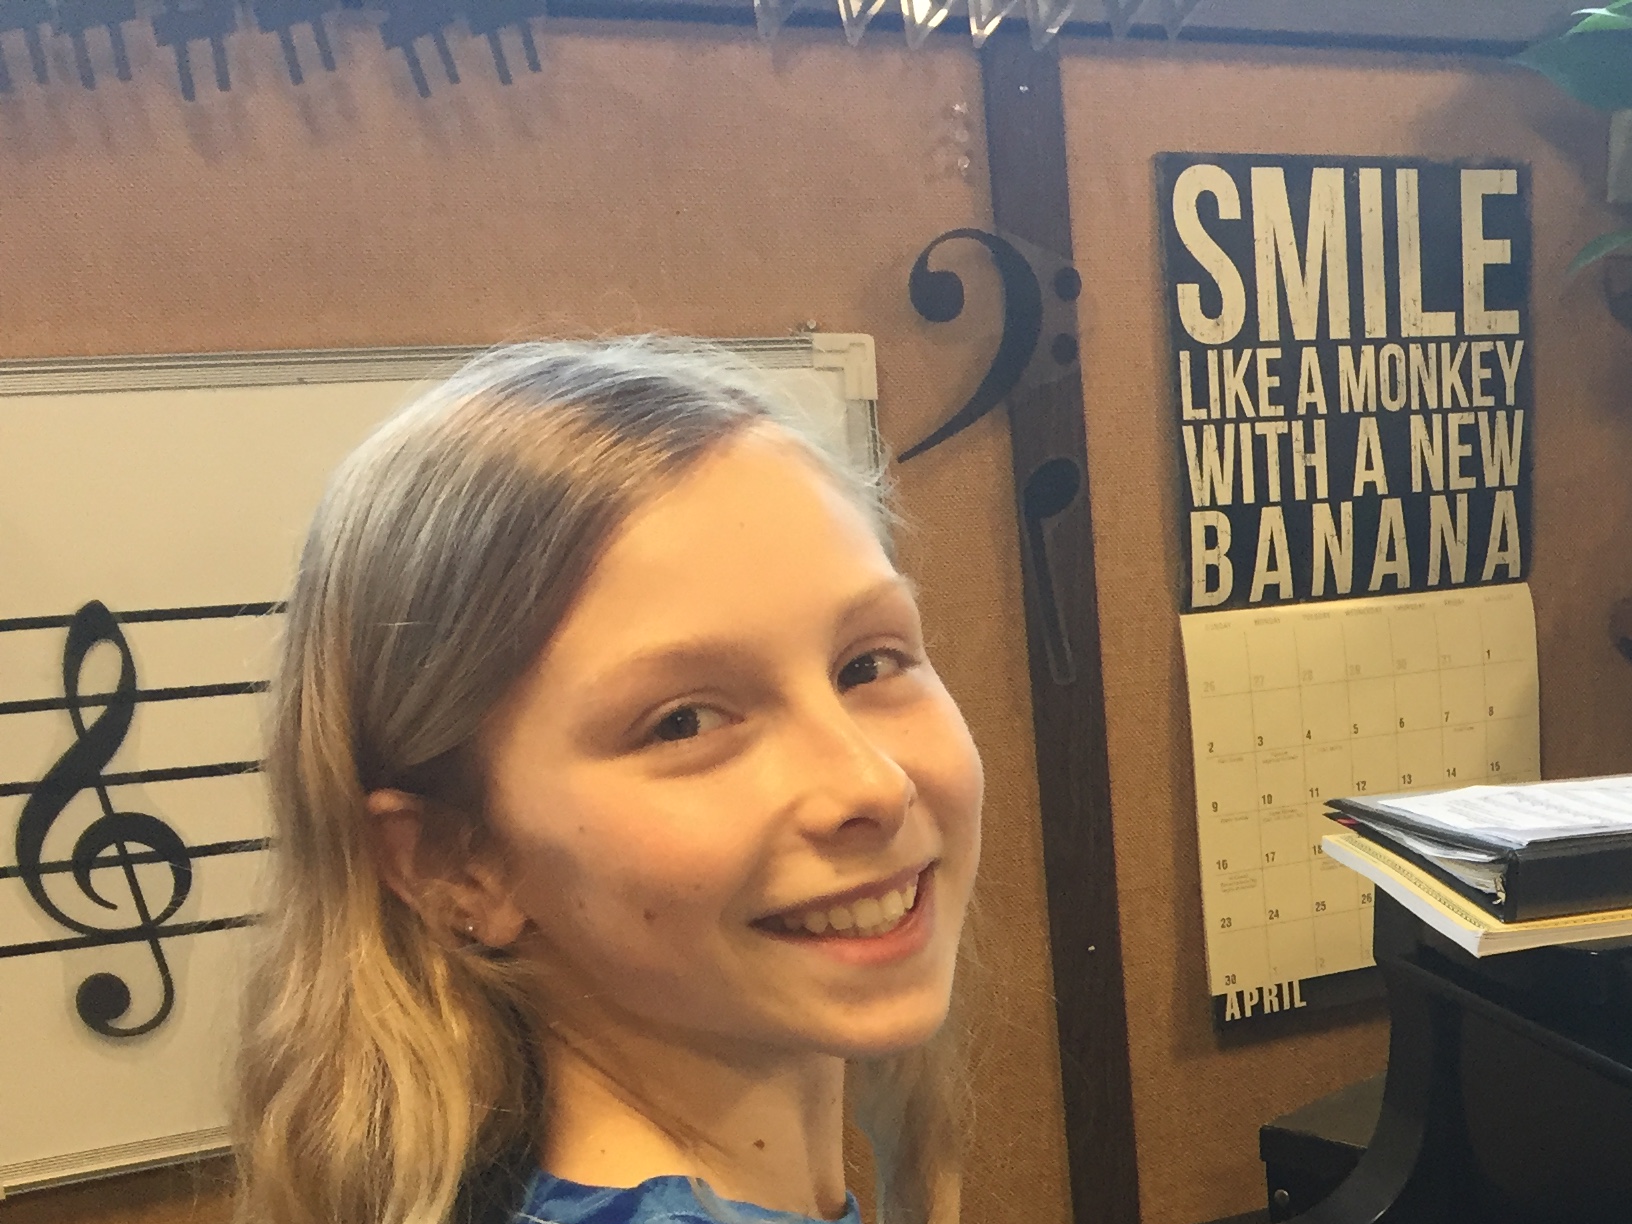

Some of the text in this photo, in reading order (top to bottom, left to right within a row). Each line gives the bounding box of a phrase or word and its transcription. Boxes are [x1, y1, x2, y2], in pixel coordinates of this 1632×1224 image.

[1172, 163, 1520, 345] SMILE
[1180, 340, 1524, 421] LIKE A MONKEY
[1183, 410, 1524, 506] WITH A NEW
[1191, 490, 1521, 608] BANANA
[1207, 742, 1214, 753] 2
[1257, 736, 1264, 746] 3
[1305, 729, 1312, 740] 4
[1353, 724, 1359, 734] 5
[1444, 711, 1450, 722] 7
[1488, 706, 1494, 716] 8
[1211, 761, 1500, 812] 9 10 11 12 13 14 15
[1216, 859, 1228, 870] 16
[1265, 852, 1276, 863] 17
[1220, 893, 1372, 929] 23 24 25 26
[1225, 974, 1237, 986] 30
[1225, 979, 1307, 1021] APRIL
